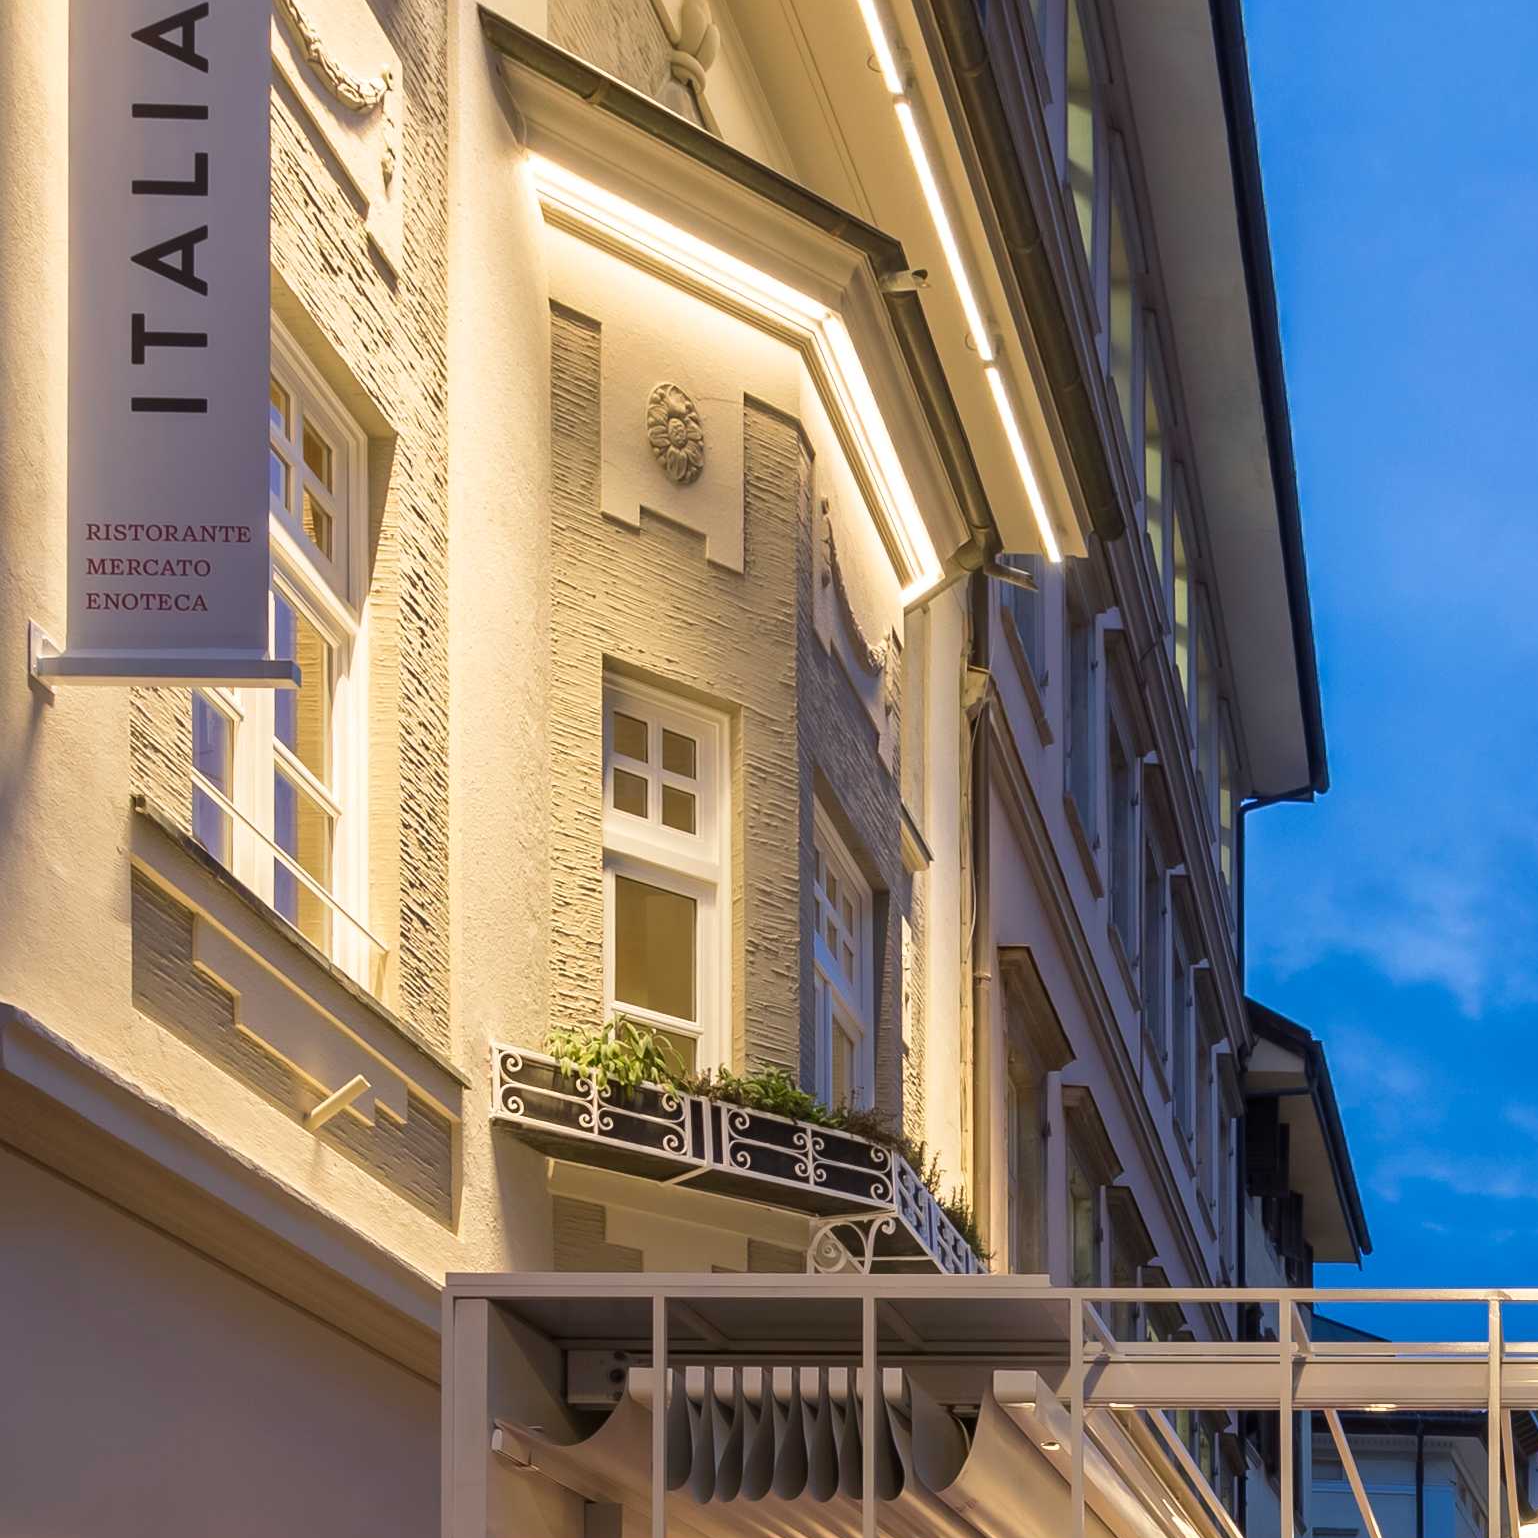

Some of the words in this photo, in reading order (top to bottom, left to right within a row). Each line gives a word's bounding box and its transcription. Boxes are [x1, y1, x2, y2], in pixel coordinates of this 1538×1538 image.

[131, 1, 209, 414] ITALIA
[86, 523, 251, 543] RISTORANTE
[86, 558, 211, 577] MERCATO
[86, 592, 208, 612] ENOTECA
